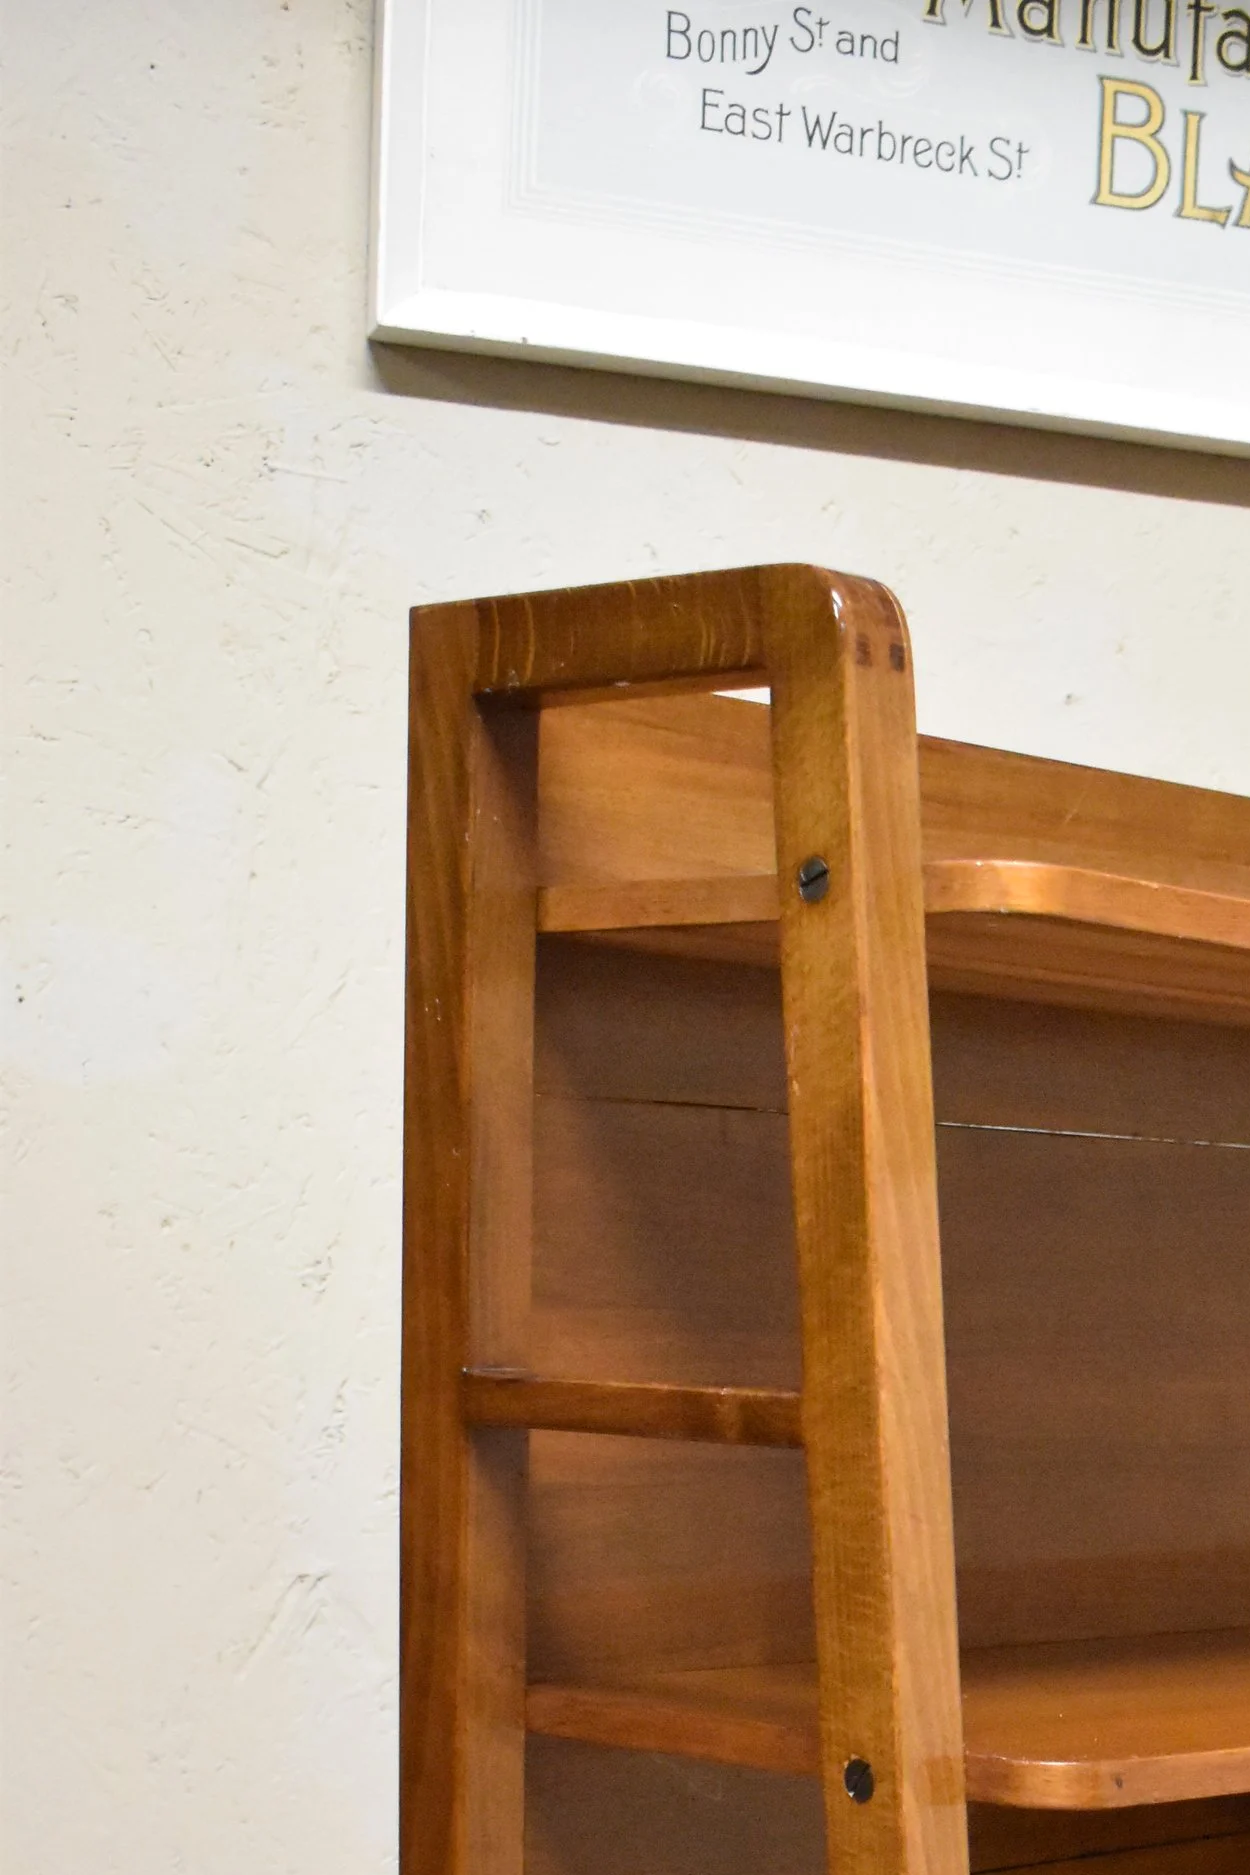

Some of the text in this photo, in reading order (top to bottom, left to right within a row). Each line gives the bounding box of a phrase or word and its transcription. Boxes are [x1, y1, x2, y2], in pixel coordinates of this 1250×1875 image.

[665, 10, 779, 75] Bonny
[835, 30, 900, 64] and
[700, 88, 792, 142] East
[801, 105, 979, 177] Warbreck
